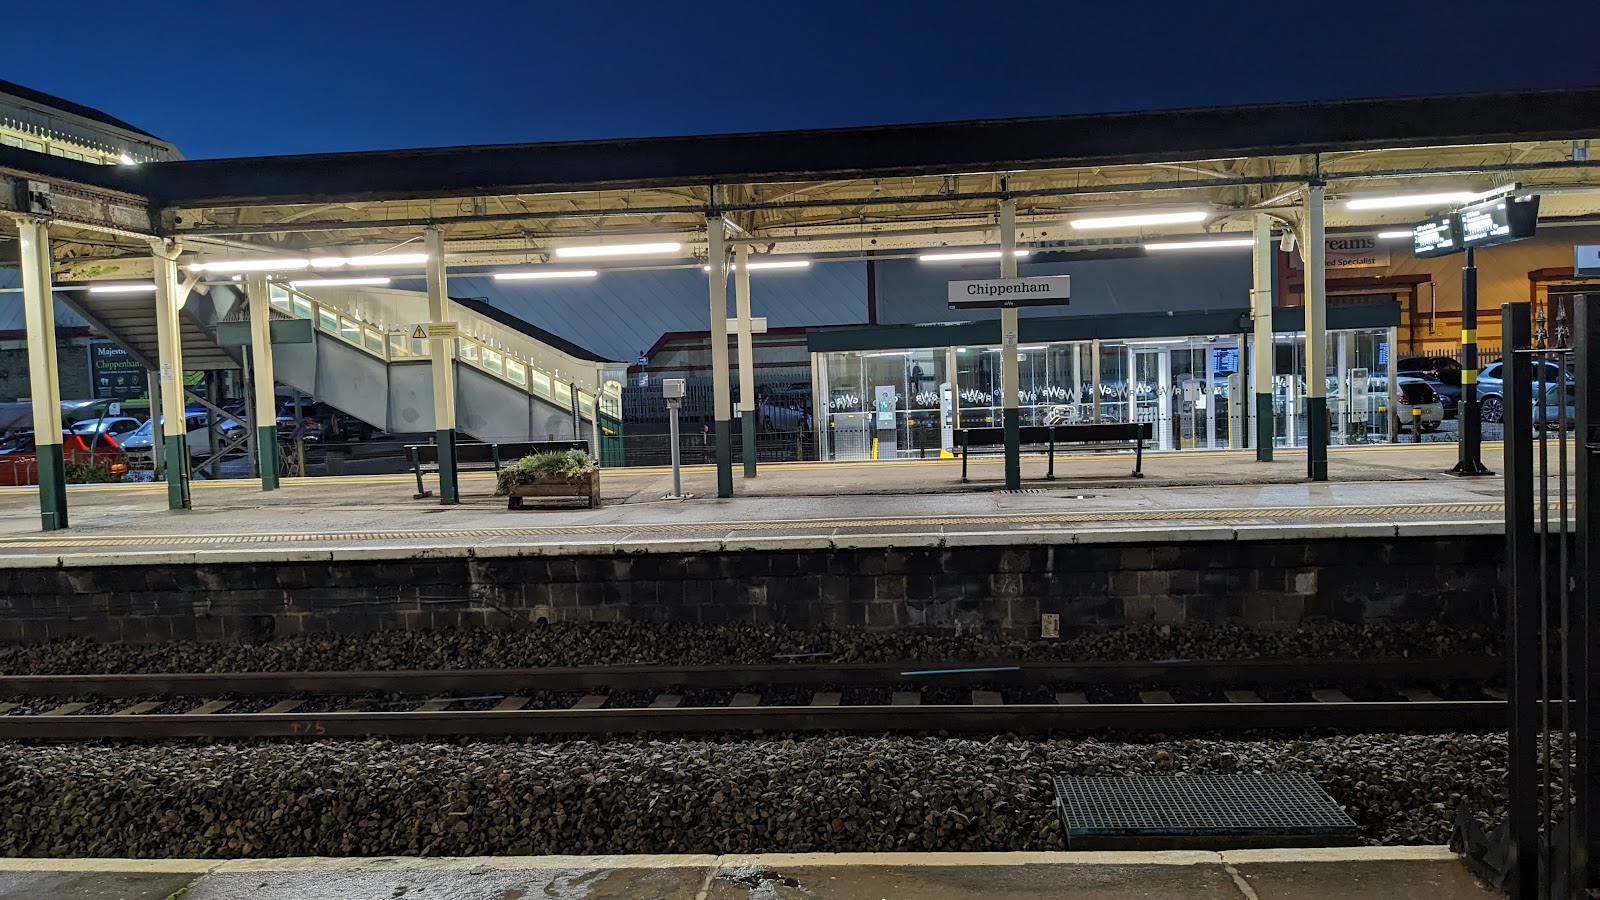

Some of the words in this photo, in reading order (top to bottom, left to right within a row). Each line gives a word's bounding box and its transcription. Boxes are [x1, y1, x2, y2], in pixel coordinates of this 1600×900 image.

[1325, 238, 1375, 250] reams
[1338, 258, 1376, 266] Specialist
[967, 283, 1050, 295] Chippenham
